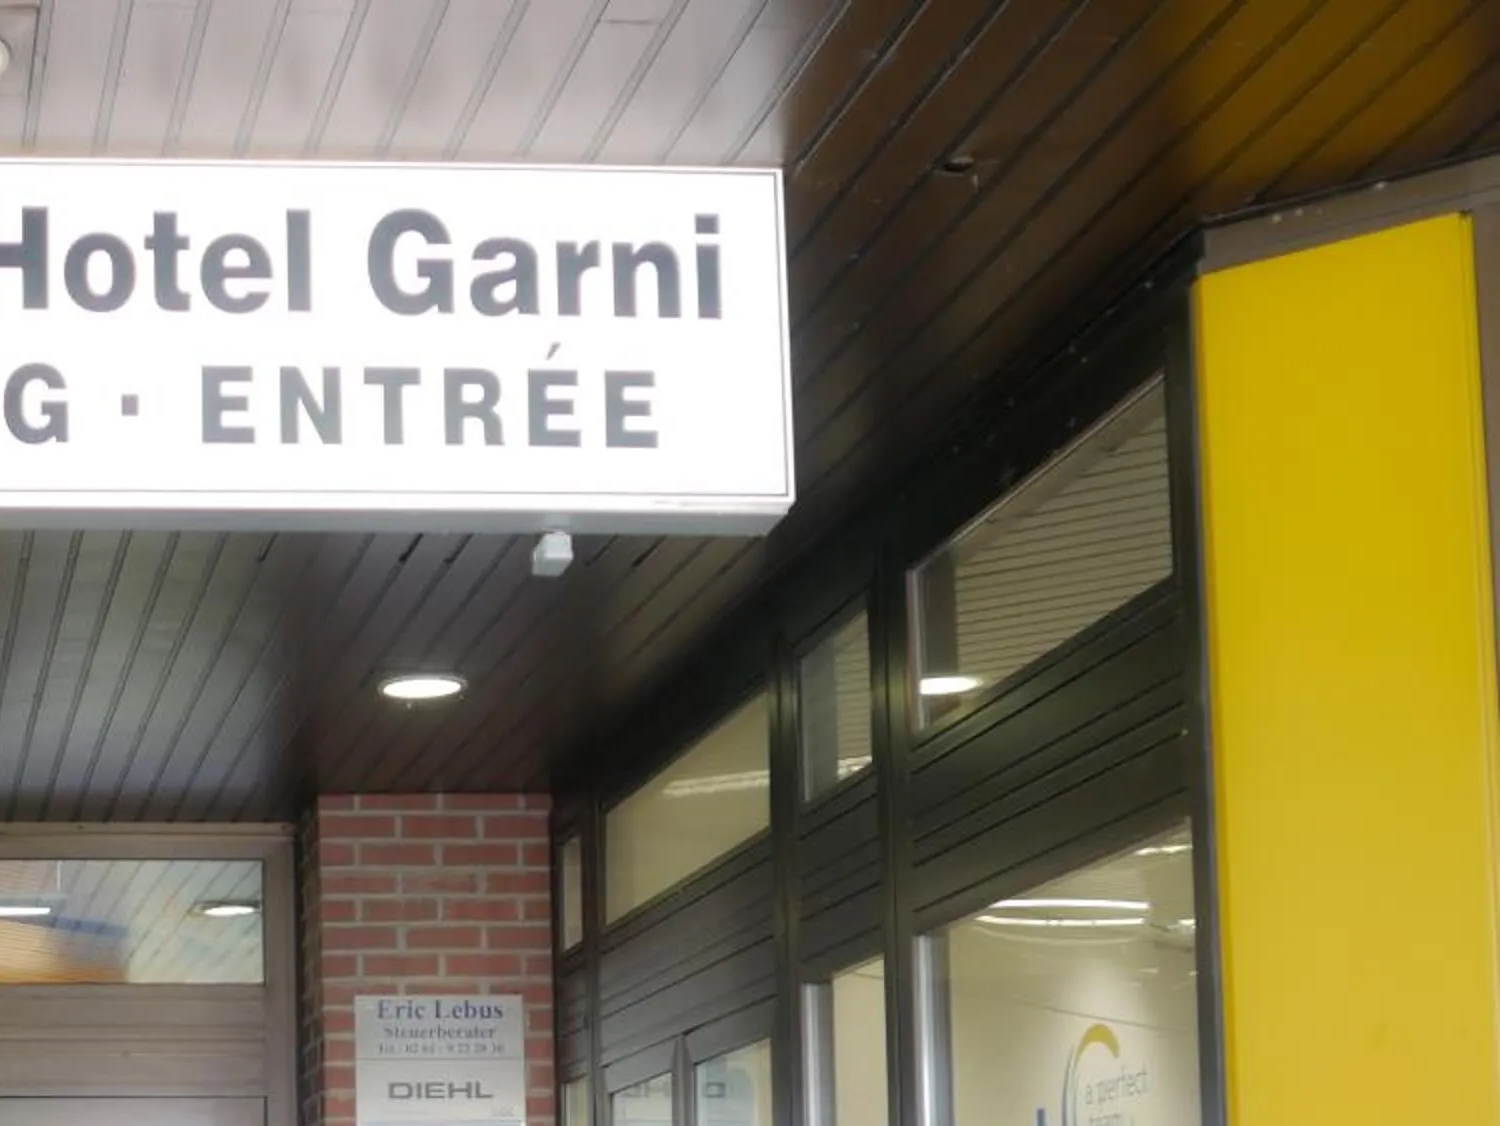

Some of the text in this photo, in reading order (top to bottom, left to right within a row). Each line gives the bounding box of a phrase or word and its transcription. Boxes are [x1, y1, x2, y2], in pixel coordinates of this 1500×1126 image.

[368, 209, 721, 319] Garni
[202, 344, 657, 448] ENTRÉE
[377, 999, 504, 1020] Eric Lebus
[388, 1081, 493, 1099] DIEHL
[1097, 1065, 1149, 1104] perfect
